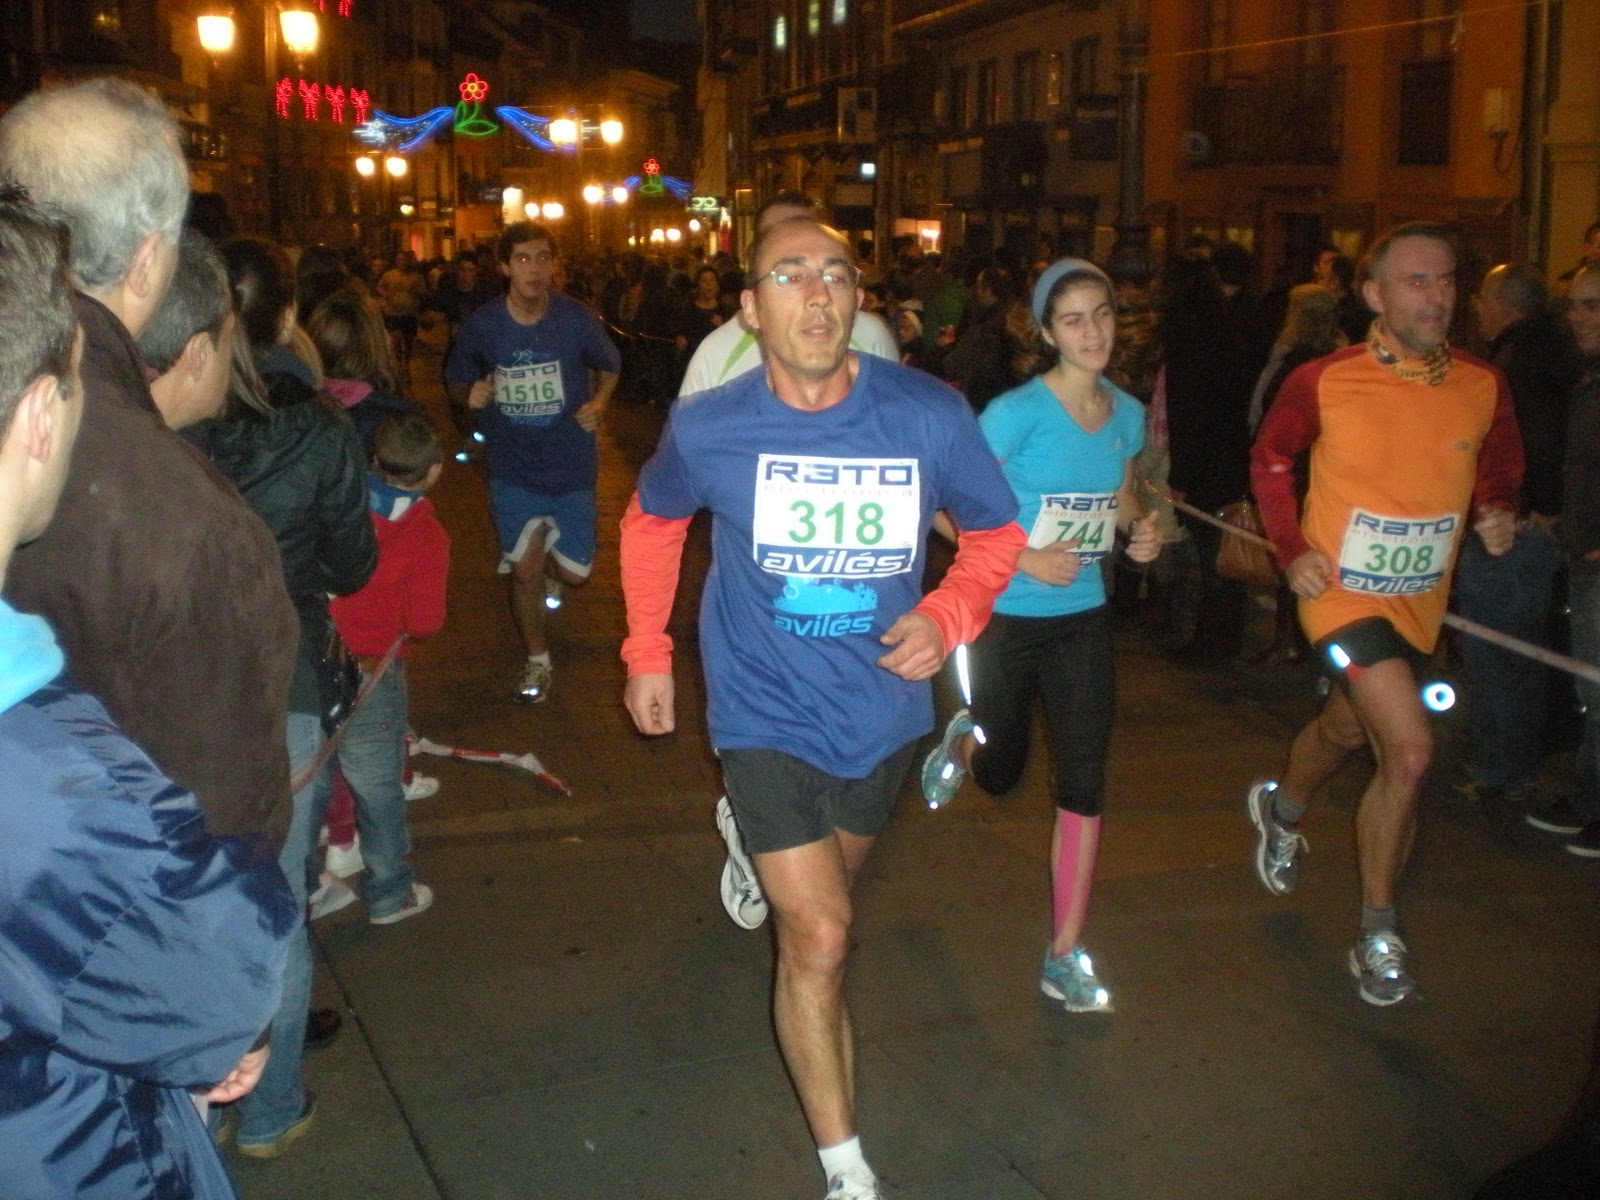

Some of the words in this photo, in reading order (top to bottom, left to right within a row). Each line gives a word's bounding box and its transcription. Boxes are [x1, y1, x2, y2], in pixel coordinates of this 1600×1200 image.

[502, 381, 555, 402] 1516
[788, 500, 884, 545] 318
[1056, 520, 1106, 549] 744
[763, 550, 906, 573] avilés
[1364, 543, 1434, 575] 308
[774, 614, 874, 637] avilés
